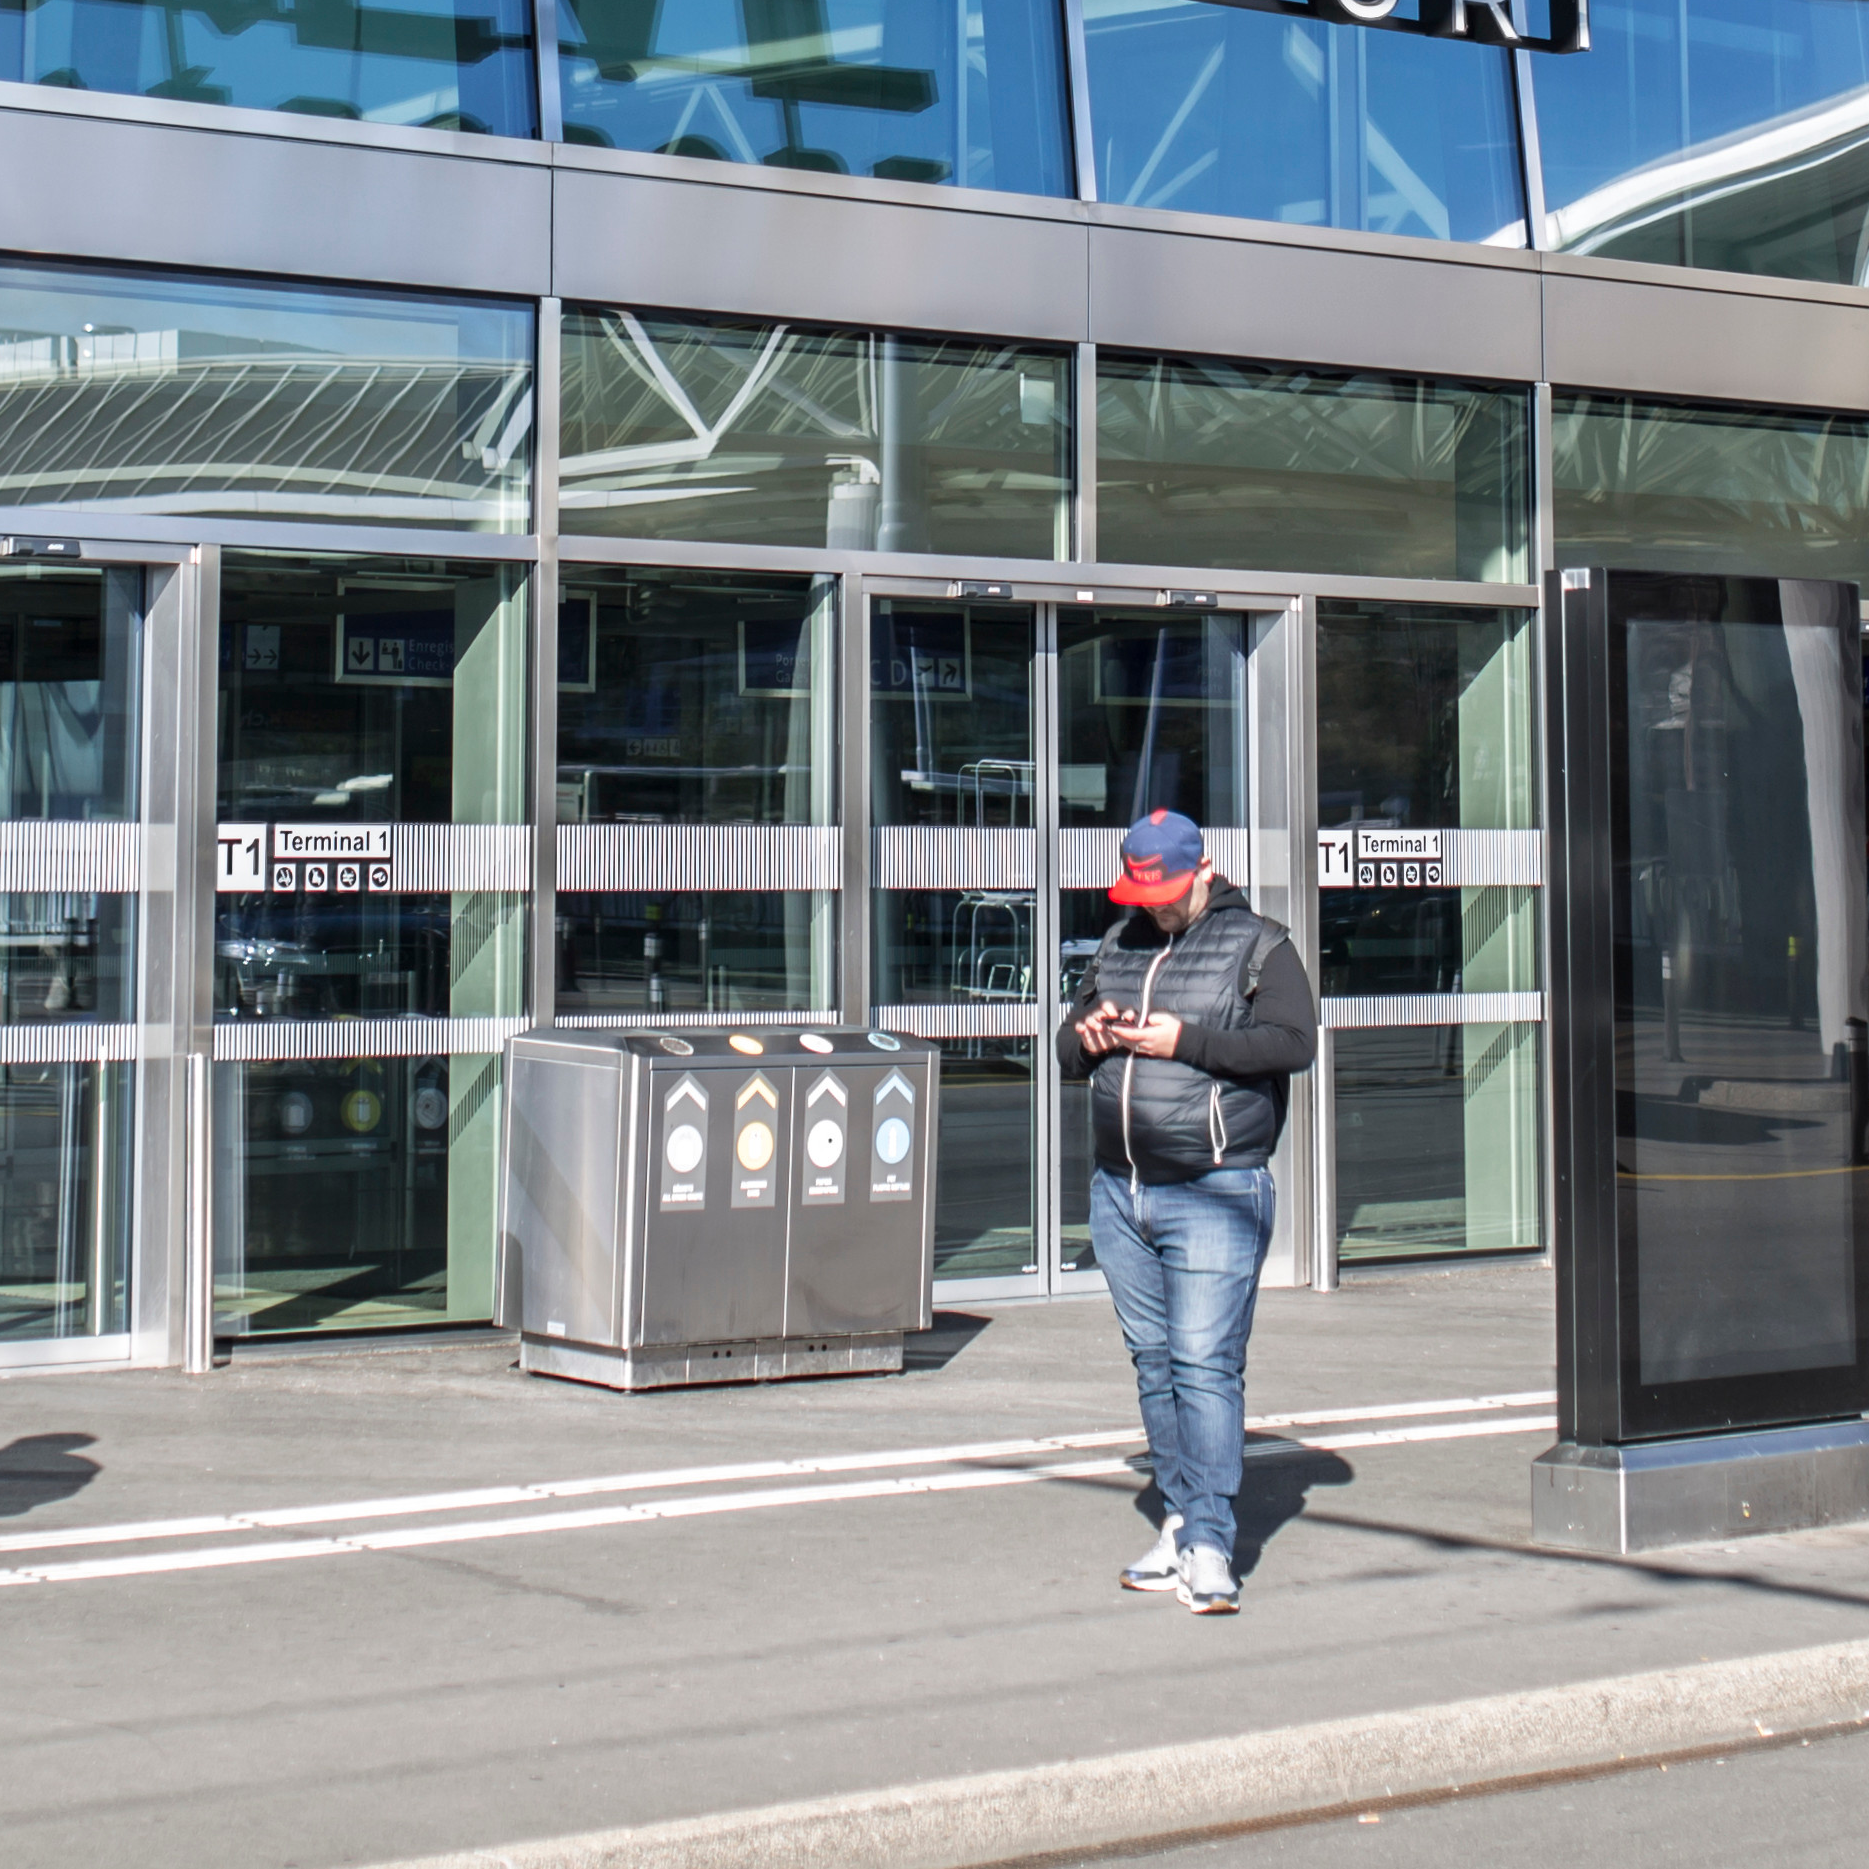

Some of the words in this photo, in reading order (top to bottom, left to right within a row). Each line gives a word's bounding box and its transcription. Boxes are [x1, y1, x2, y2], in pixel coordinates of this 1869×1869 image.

[890, 660, 907, 686] D
[279, 830, 370, 852] Terminal
[378, 830, 387, 852] 1
[1362, 835, 1427, 853] Terminal
[1432, 835, 1438, 853] 1
[217, 838, 260, 876] T1
[1318, 842, 1349, 874] T1
